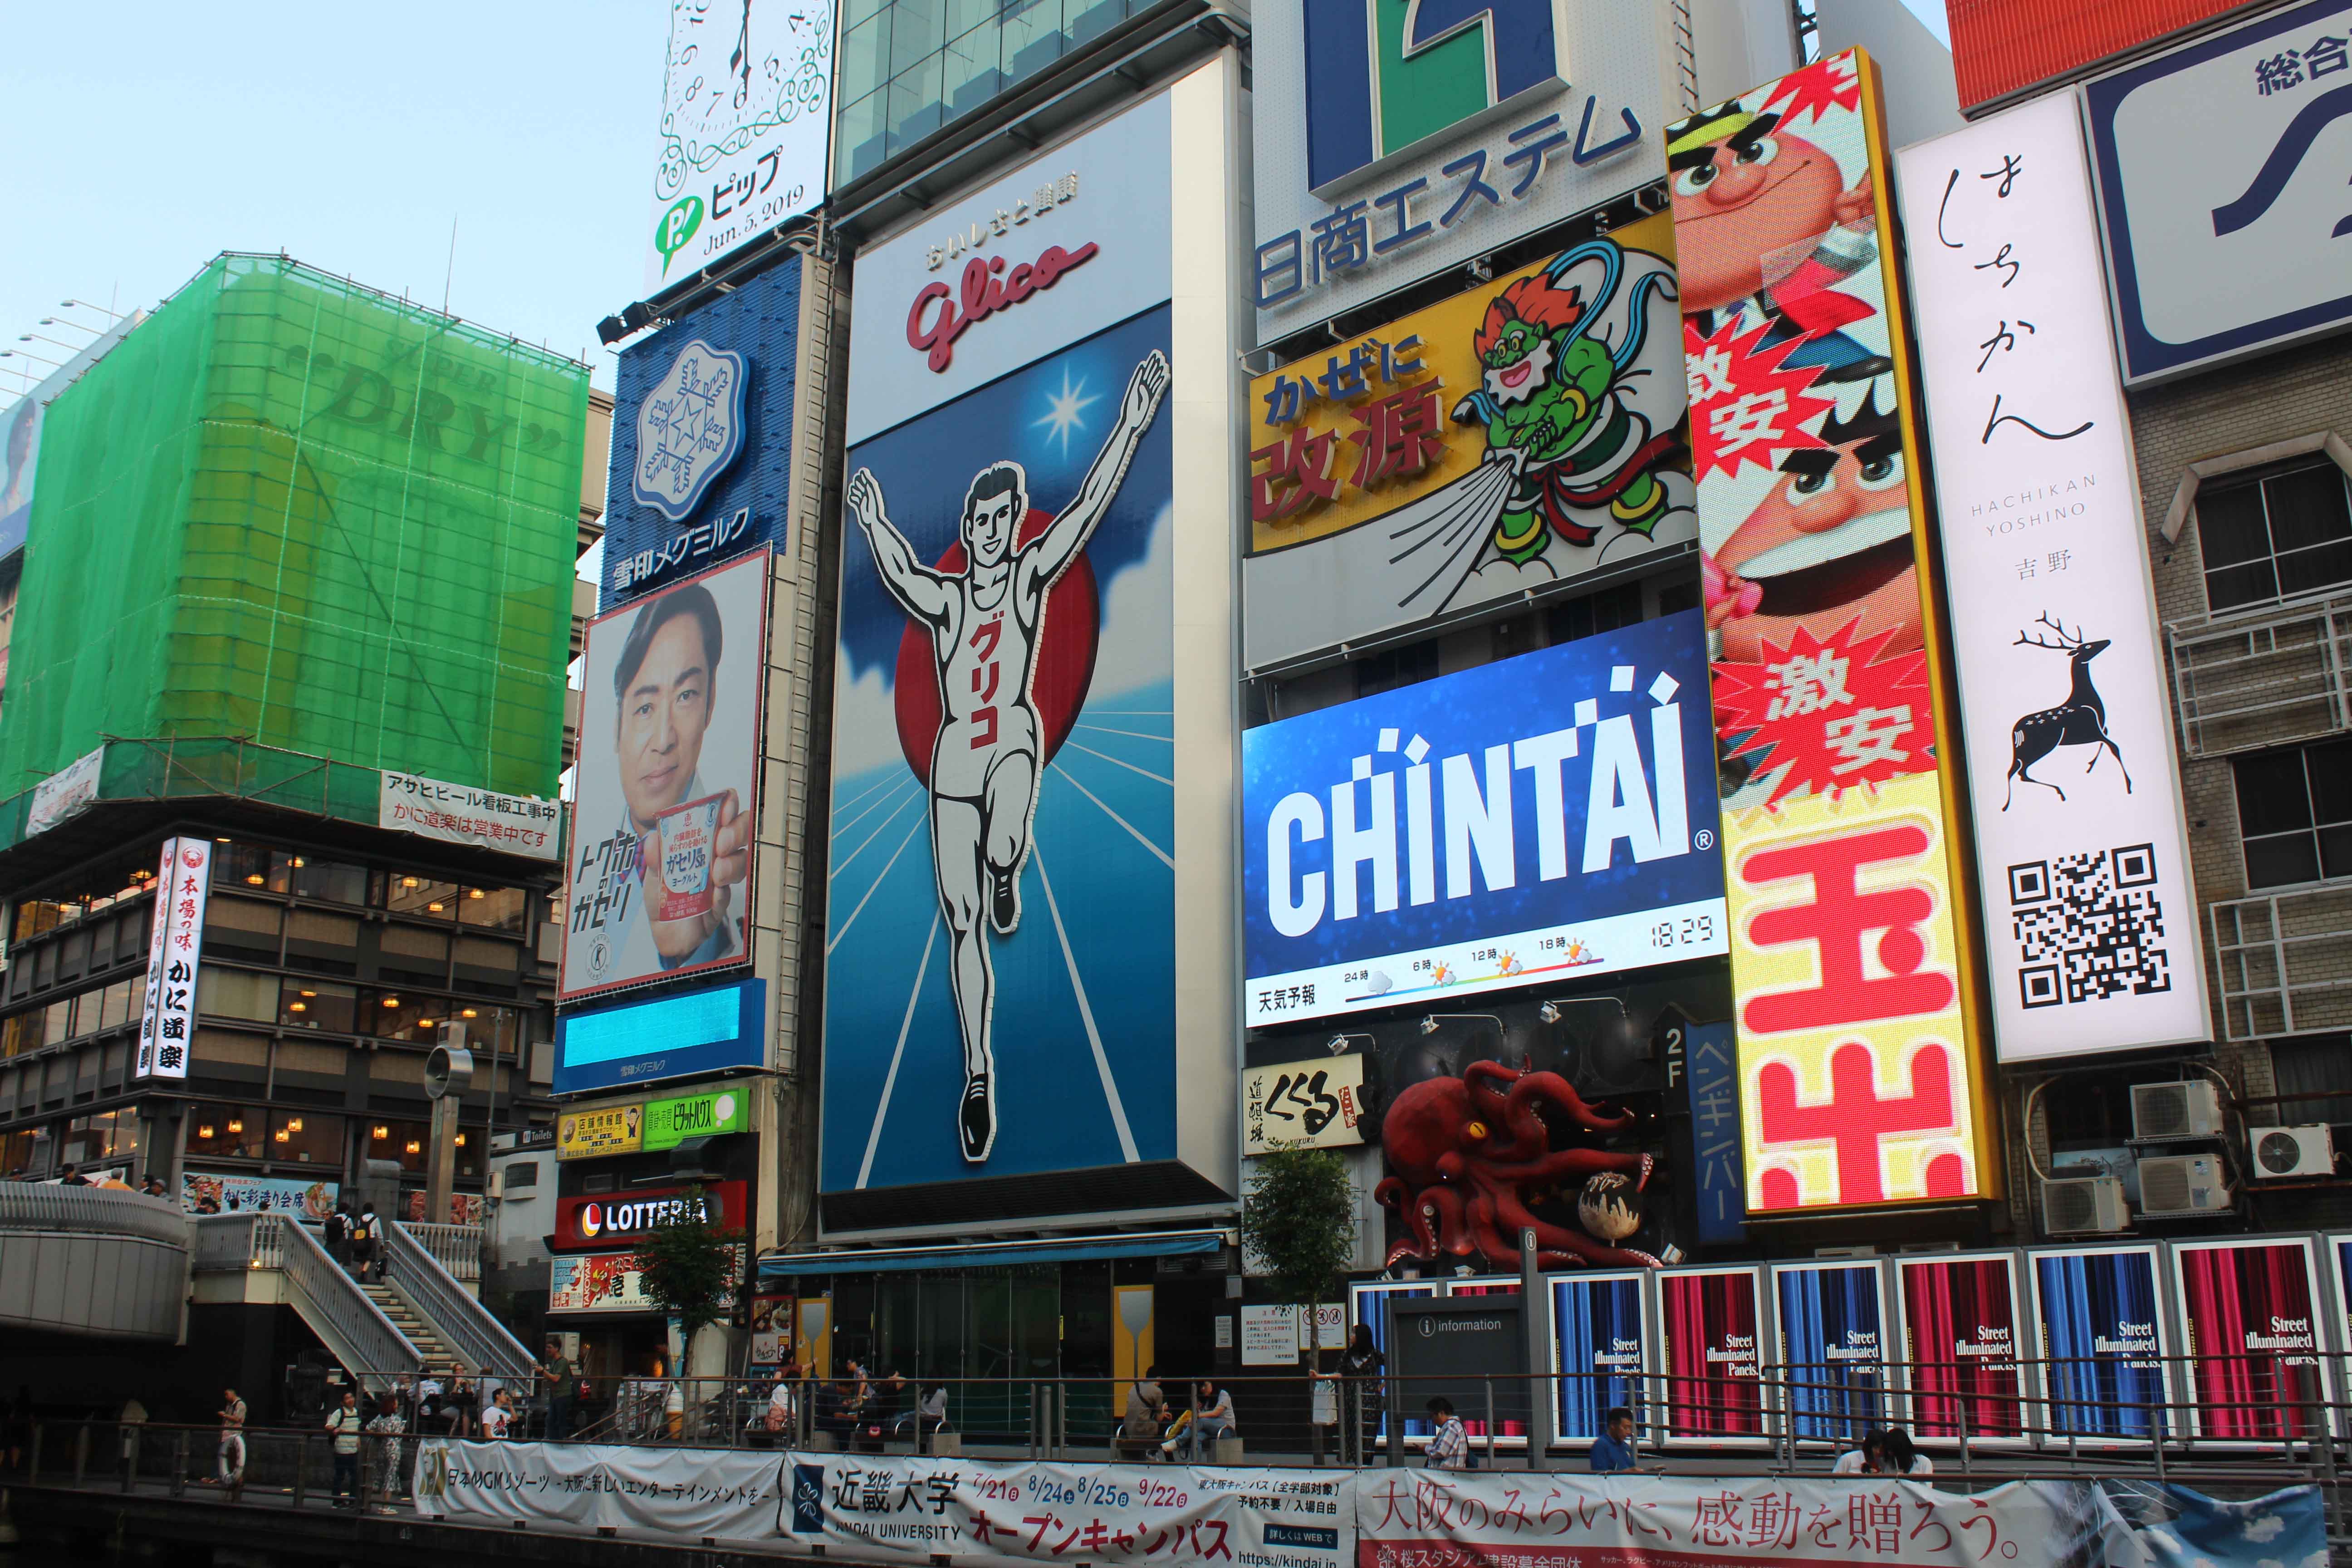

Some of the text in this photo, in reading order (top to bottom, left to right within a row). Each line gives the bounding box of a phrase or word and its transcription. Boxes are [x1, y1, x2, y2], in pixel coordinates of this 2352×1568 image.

[711, 145, 783, 220] ピップ
[703, 230, 741, 255] Jun.
[761, 184, 804, 223] 2019
[1255, 94, 1644, 309] 日商エステム
[926, 170, 1078, 271] おいしさと健康
[906, 241, 1100, 374] Glico
[1264, 333, 1427, 426] かぜに
[1249, 375, 1448, 524] 改源
[1971, 473, 2097, 518] HACHIKAN
[1985, 501, 2086, 537] YOSHINO
[612, 506, 751, 592] 雪印メグミルク
[2014, 548, 2072, 581] 吉野
[969, 610, 1005, 750] グリコ
[1766, 649, 1913, 775] 激安
[387, 774, 557, 822] アサヒビール看板工事中
[1267, 665, 1690, 938] CHINTAI
[393, 803, 549, 848] かに道楽は営業中です
[666, 848, 697, 876] ガセリ
[672, 873, 698, 887] ヨーグルト
[174, 874, 199, 952] 本場の味
[573, 884, 631, 934] ガセリ
[1471, 948, 1497, 962] 12時
[1539, 937, 1566, 951] 18時
[1344, 970, 1369, 984] 24時
[1412, 959, 1431, 972] 6時
[1258, 984, 1316, 1012] 天気予報
[620, 1058, 666, 1078] 雪印メグミルク
[673, 1098, 712, 1132] ピタットハウス
[1248, 1075, 1264, 1144] 道頓堀
[1264, 1070, 1339, 1135] くくる
[531, 1128, 553, 1141] Toilets
[1289, 1137, 1316, 1146] KUKURU
[1695, 1039, 1737, 1220] ペンギンバー
[224, 1188, 305, 1209] かに彩造り会席
[607, 1197, 707, 1231] LOTTERIA
[583, 1258, 592, 1307] TAKOYAKI
[1438, 1317, 1501, 1333] information
[1726, 1334, 1753, 1349] Street
[1847, 1329, 1876, 1345] Street
[1978, 1325, 2009, 1341] Street
[2119, 1320, 2152, 1336] Street
[2271, 1315, 2308, 1333] Street
[1612, 1338, 1638, 1351] Street
[2043, 1323, 2051, 1371] DOTONBRI
[2189, 1318, 2198, 1368] DOTONBRI
[1728, 1362, 1759, 1377] Panels.
[448, 1468, 549, 1493] 日本MGMリゾーツ
[832, 1468, 960, 1515] 近畿大学
[1237, 1494, 1281, 1511] 予約不要
[1294, 1498, 1337, 1515] 入場自由
[1372, 1479, 2018, 1561] 大阪のみらいに、感動を贈ろう。
[880, 1524, 961, 1541] UNIVERSITY
[969, 1509, 1232, 1562] オープンキャンパス
